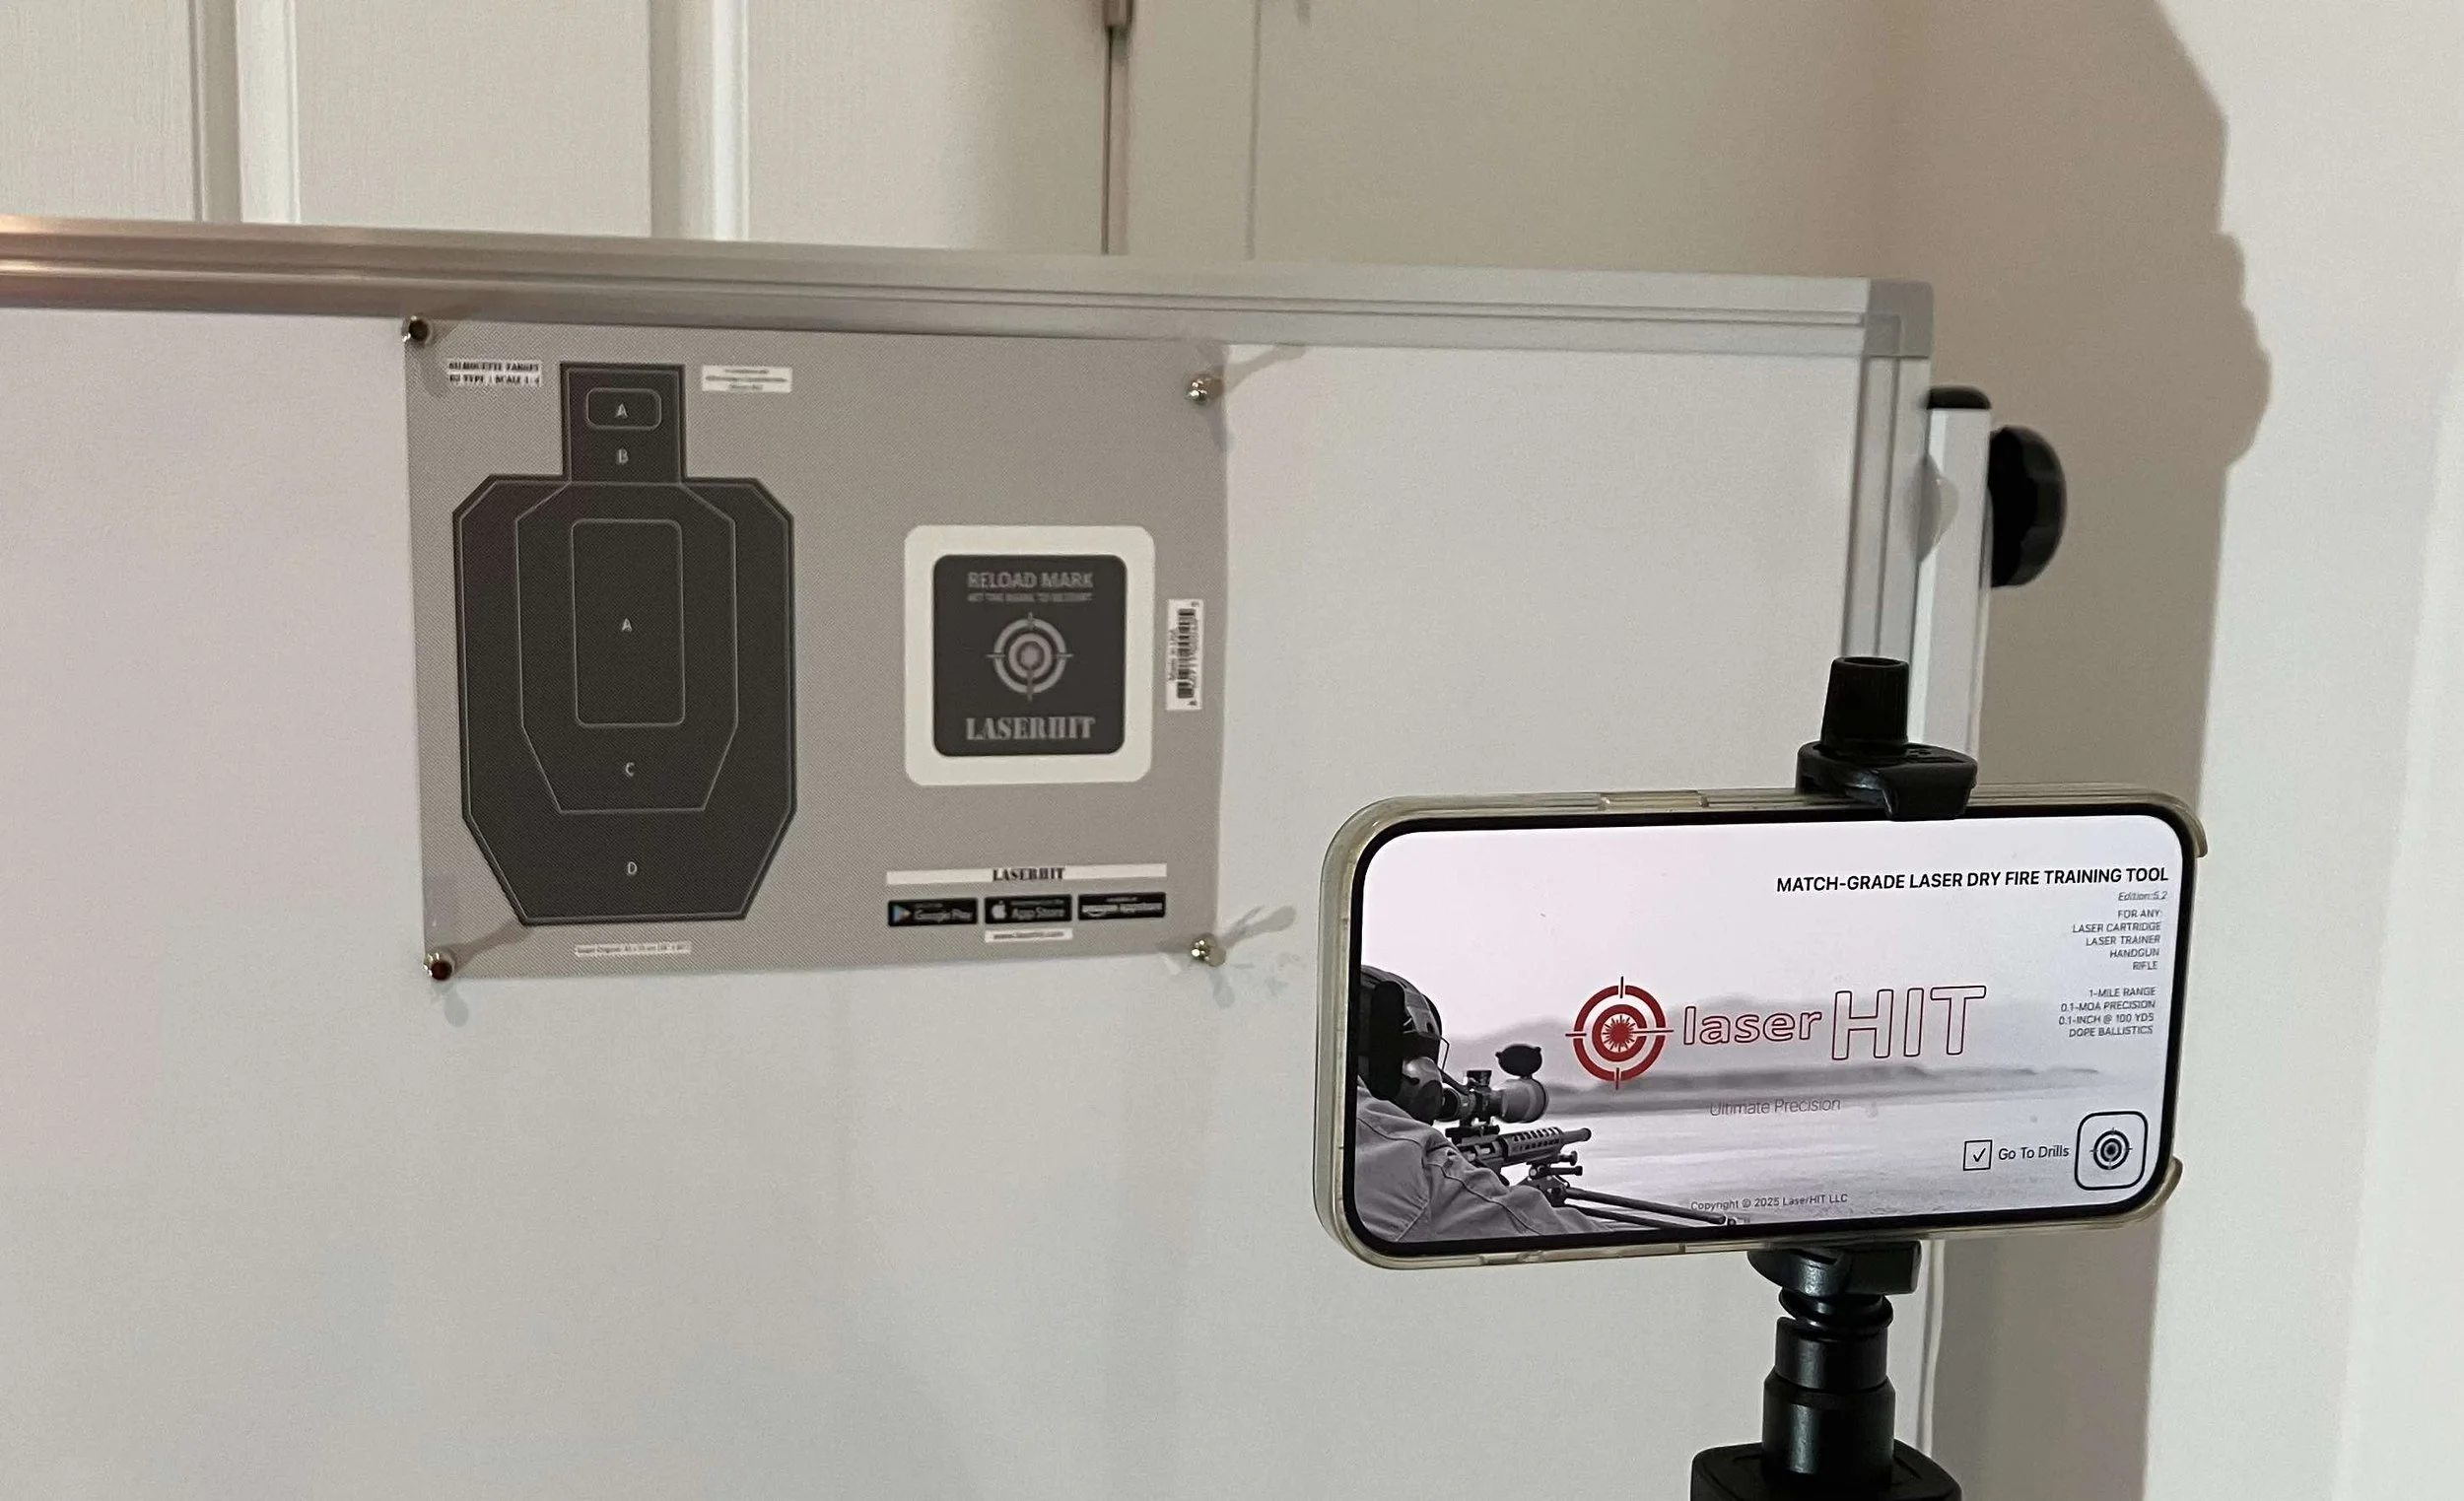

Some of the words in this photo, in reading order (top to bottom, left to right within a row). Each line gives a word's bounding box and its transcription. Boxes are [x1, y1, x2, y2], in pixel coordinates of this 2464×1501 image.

[614, 402, 629, 419] A
[616, 447, 630, 466] B
[966, 571, 1038, 589] RELOAD
[1040, 571, 1094, 588] MARK
[621, 618, 633, 632] A
[625, 761, 636, 778] C
[627, 860, 638, 876] D
[1776, 874, 1906, 892] MATCH-GRADE
[1909, 873, 1963, 888] LASER
[1966, 871, 2002, 887] DRY
[2005, 870, 2040, 885] FIRE
[2044, 867, 2122, 884] TRAINING
[2126, 866, 2169, 882] TOOL
[2117, 909, 2138, 919] FOR
[2072, 922, 2104, 933] LASER
[2106, 921, 2161, 932] CARTRIDGE
[2086, 935, 2116, 947] LASER
[2120, 934, 2161, 945] TRAINER
[2109, 948, 2160, 959] HANDGUN
[2132, 960, 2158, 971] RIFLE
[2088, 988, 2120, 998] 1-MILE
[2122, 987, 2156, 997] RANGE
[2103, 999, 2156, 1010] PRECISION
[1682, 1005, 1822, 1046] laser
[1831, 985, 1987, 1060] HIT
[2058, 1015, 2101, 1026] 0.1-INCH
[2116, 1013, 2132, 1023] 100
[2135, 1012, 2156, 1022] YDS
[2069, 1027, 2096, 1038] DOPE
[2097, 1025, 2155, 1037] BALLISTICS
[1709, 1101, 1770, 1117] Ultimate
[1774, 1098, 1841, 1113] Precision
[1998, 1147, 2017, 1161] Go
[2020, 1146, 2035, 1159] To
[2038, 1144, 2071, 1158] Drills
[1690, 1200, 1739, 1212] Copyright
[1754, 1197, 1780, 1207] 2025
[1782, 1194, 1826, 1206] LaserHIT
[1829, 1194, 1848, 1203] LLC
